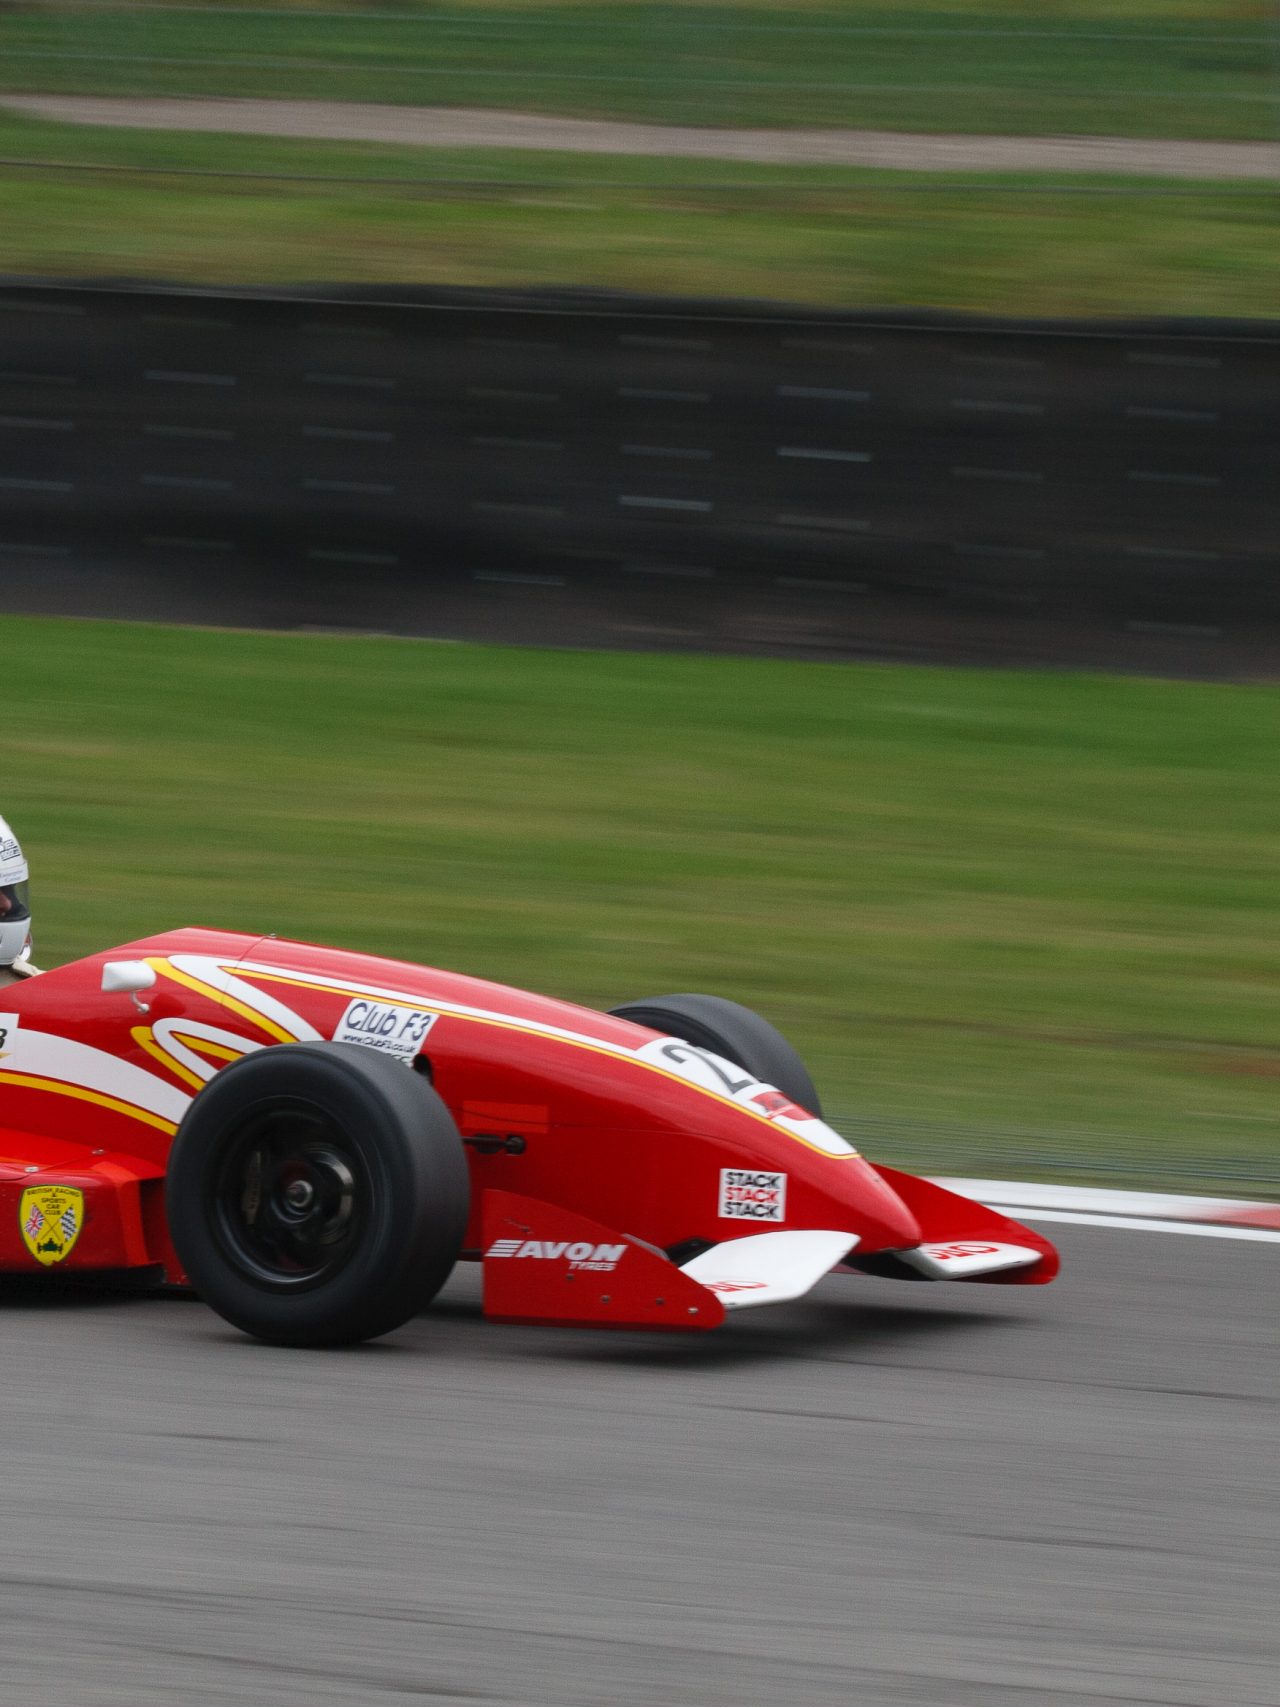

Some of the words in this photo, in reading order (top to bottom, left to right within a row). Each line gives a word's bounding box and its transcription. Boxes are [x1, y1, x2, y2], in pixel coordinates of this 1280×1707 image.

[347, 1002, 398, 1036] Club
[398, 1013, 432, 1041] F3
[725, 1172, 780, 1189] STACK
[725, 1187, 780, 1203] STACK
[724, 1201, 779, 1219] STACK
[514, 1240, 629, 1261] AVON
[568, 1261, 618, 1272] TYRES
